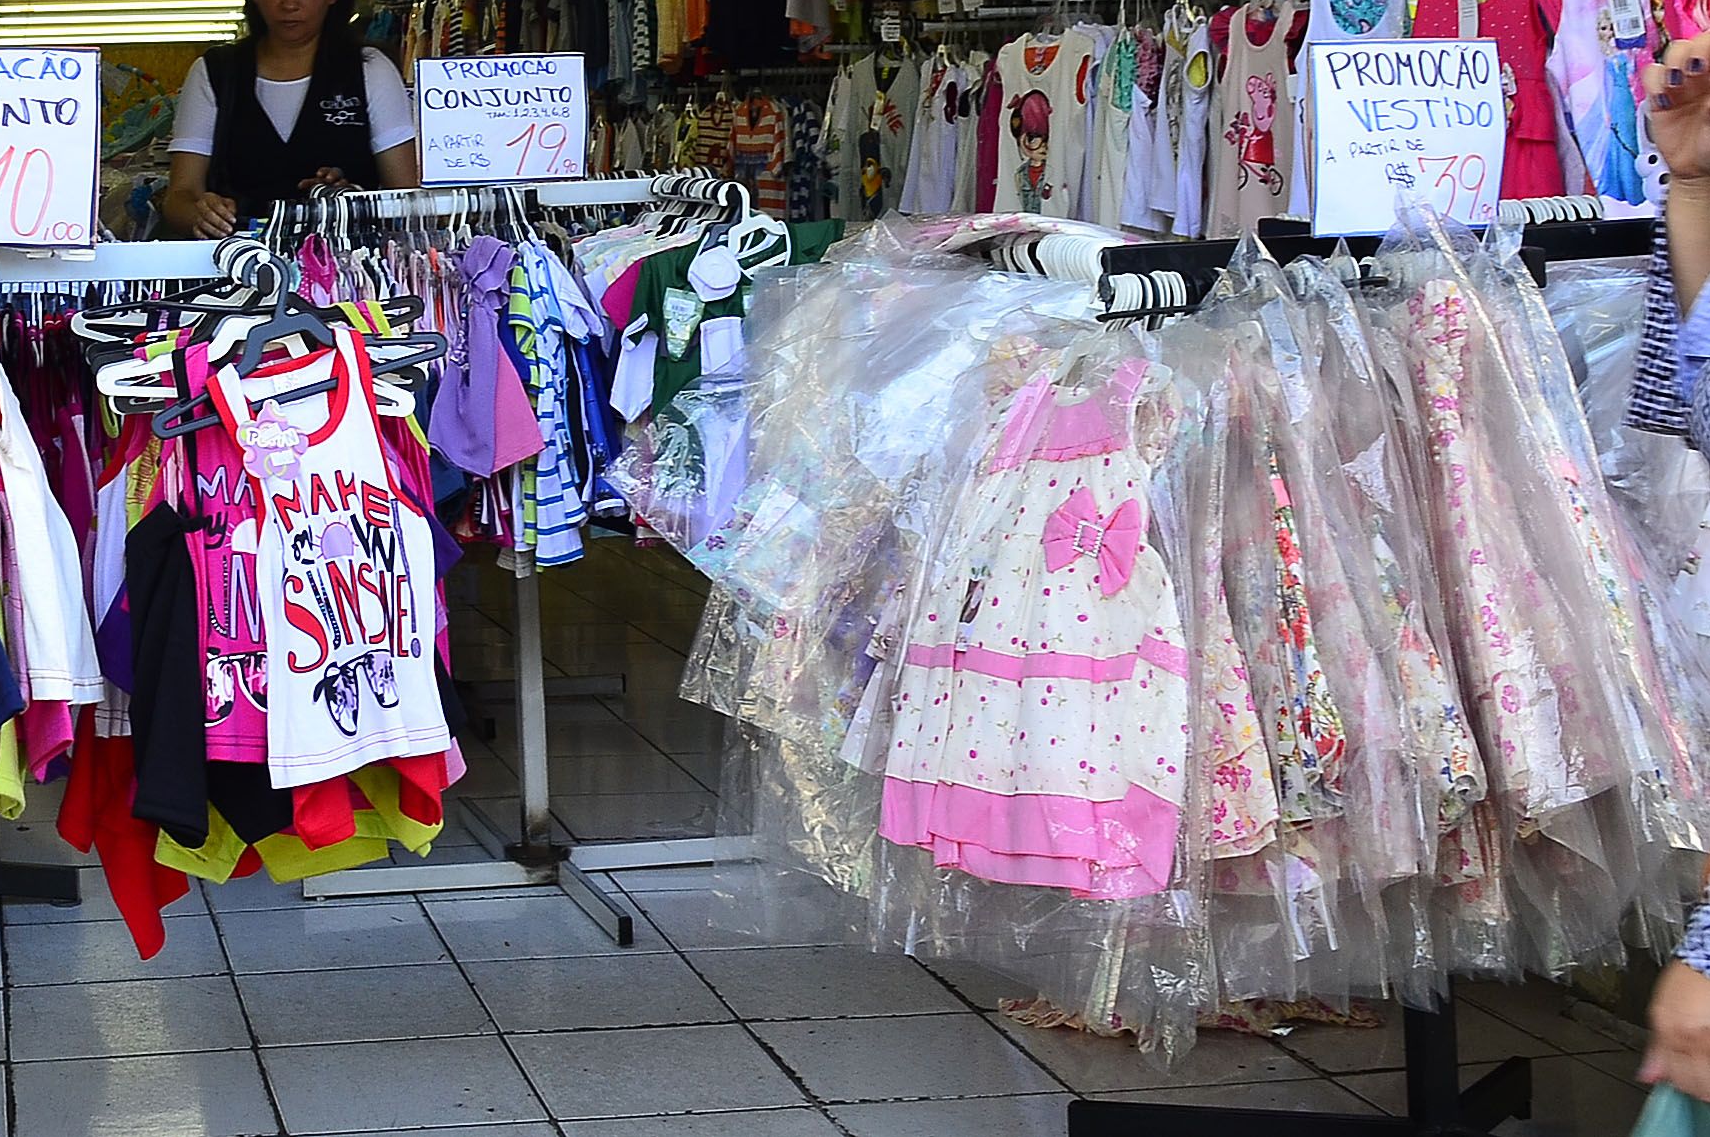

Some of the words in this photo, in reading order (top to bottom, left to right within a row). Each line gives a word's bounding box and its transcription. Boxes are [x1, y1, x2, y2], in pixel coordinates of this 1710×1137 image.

[425, 87, 572, 109] CONJUNTO
[444, 158, 466, 168] DE
[1325, 149, 1336, 163] A
